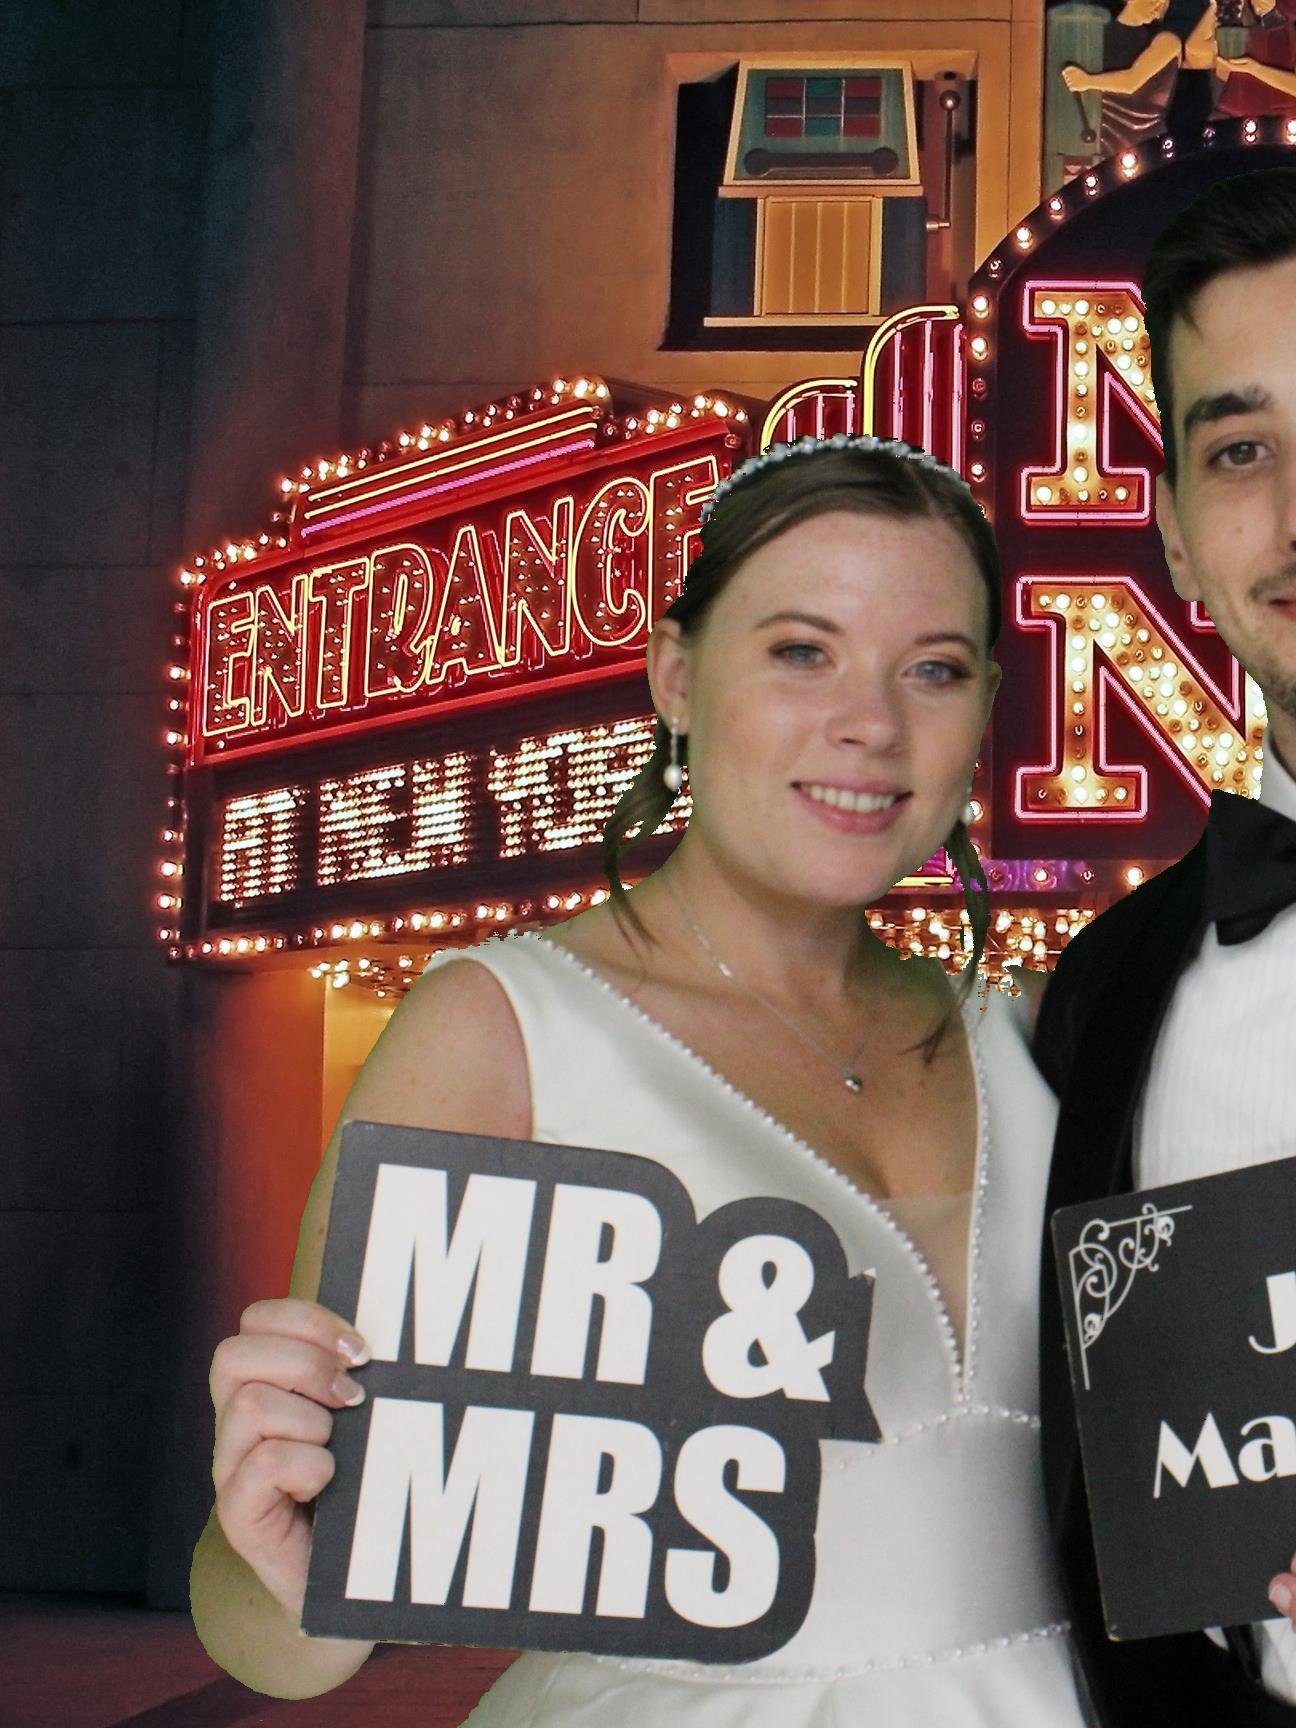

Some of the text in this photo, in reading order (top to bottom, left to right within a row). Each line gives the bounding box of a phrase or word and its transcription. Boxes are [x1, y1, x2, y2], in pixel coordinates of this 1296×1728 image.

[203, 455, 718, 736] ENTRANCE
[354, 1163, 836, 1403] MR &
[344, 1396, 787, 1629] MRS
